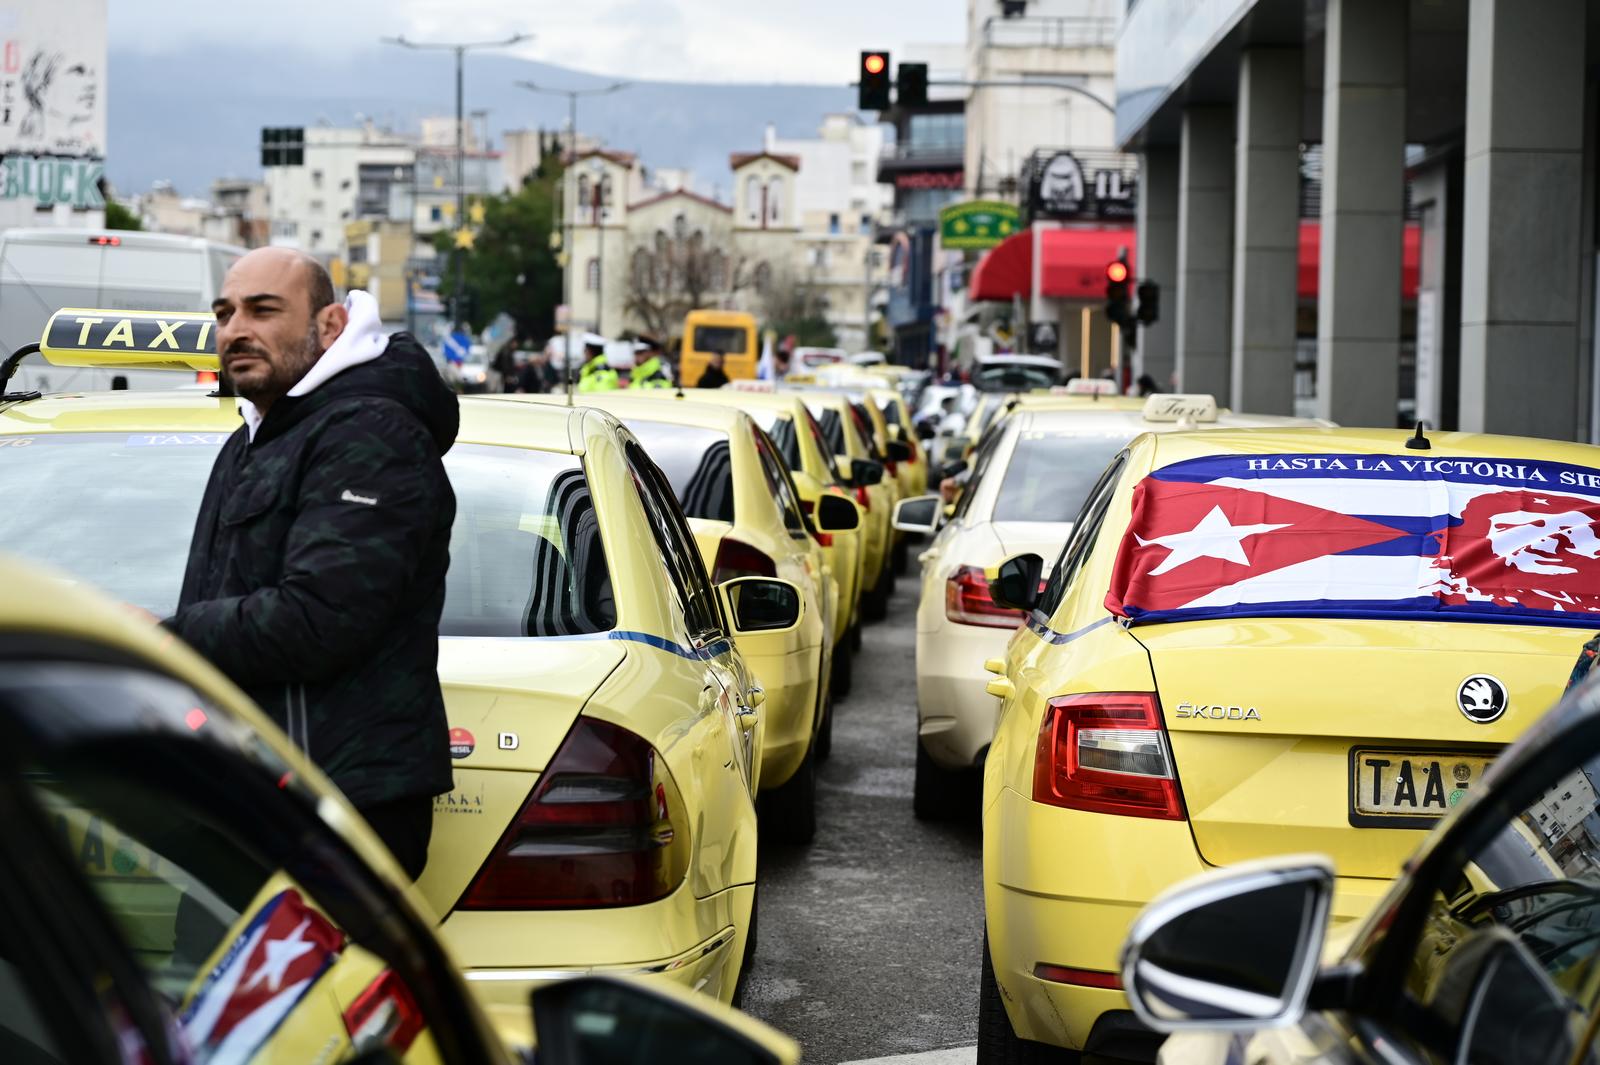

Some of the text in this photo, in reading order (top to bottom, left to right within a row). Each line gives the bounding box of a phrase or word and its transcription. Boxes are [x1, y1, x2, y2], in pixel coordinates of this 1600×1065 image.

[75, 317, 212, 351] TAXI
[1155, 398, 1211, 416] Taxi
[143, 434, 226, 445] TAXI
[1247, 458, 1350, 471] HASTA
[1356, 459, 1394, 471] LA
[1399, 460, 1548, 481] VICTORIA
[1175, 702, 1261, 721] ŠKODA
[498, 732, 519, 751] D
